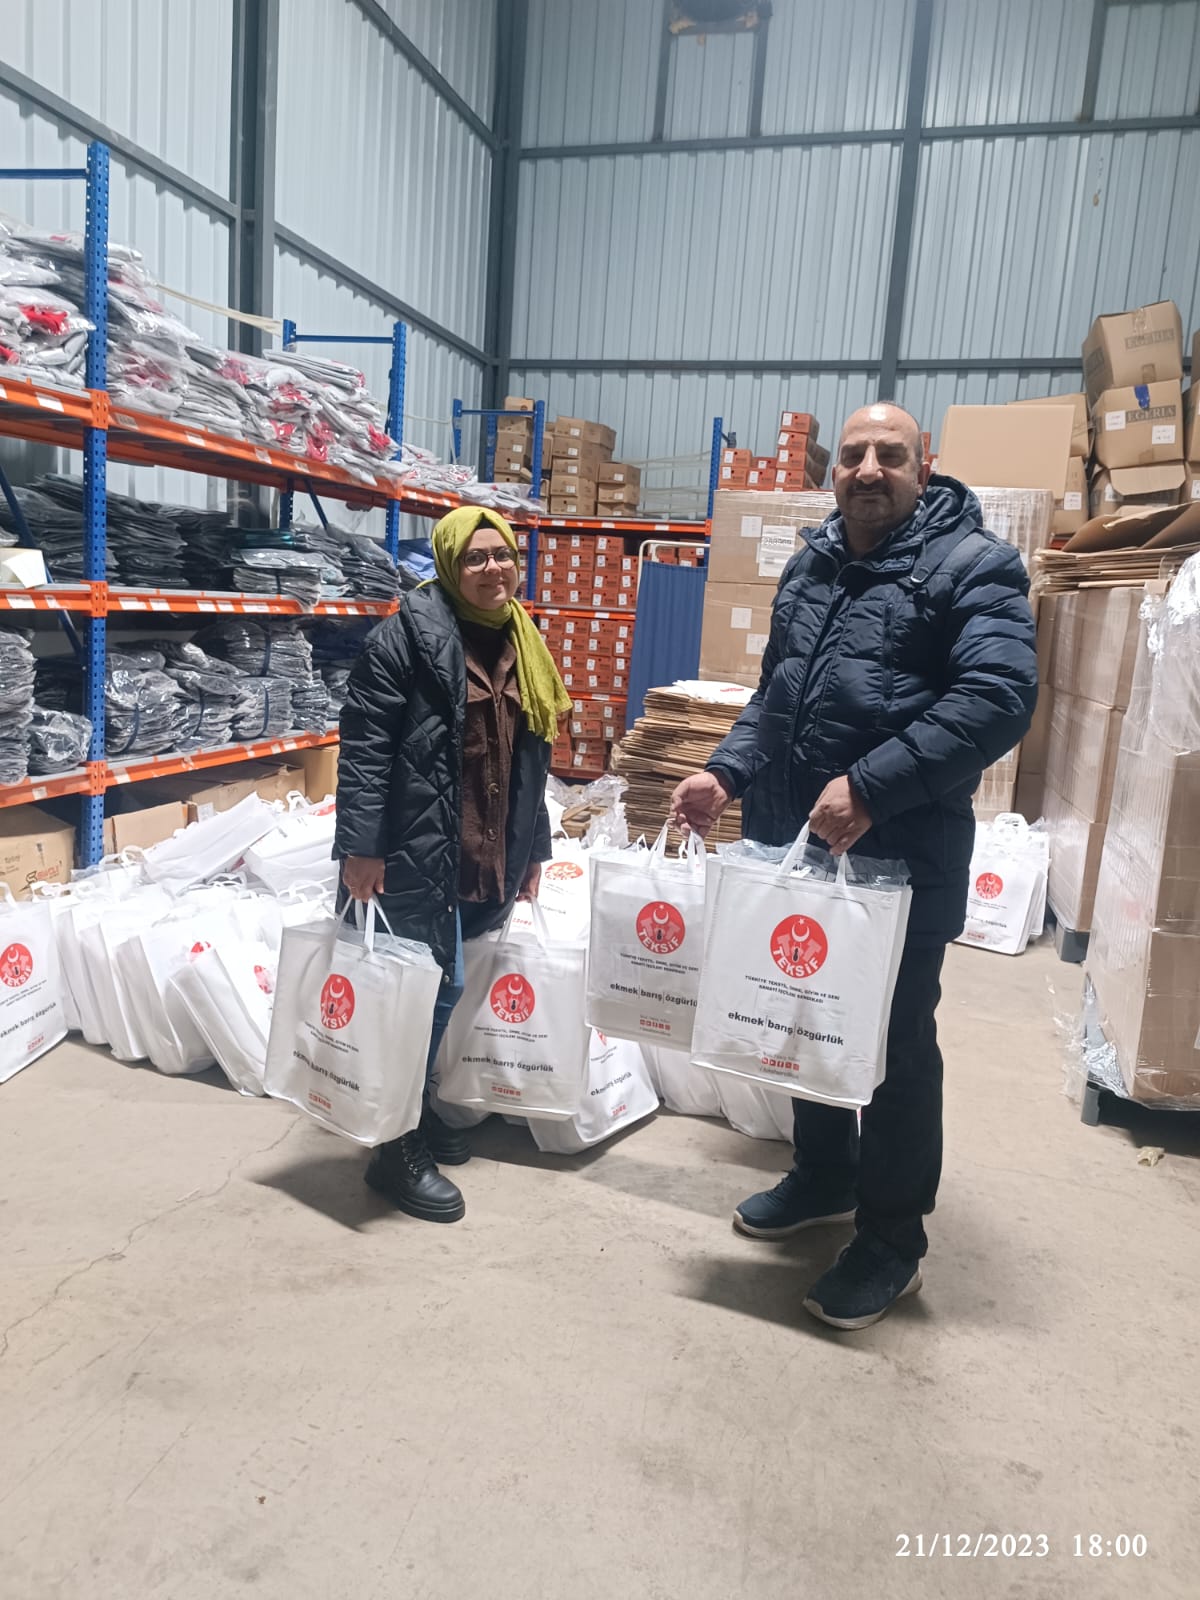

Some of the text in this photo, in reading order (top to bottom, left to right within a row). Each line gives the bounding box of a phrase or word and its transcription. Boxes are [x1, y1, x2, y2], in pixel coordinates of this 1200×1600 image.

[772, 946, 820, 977] TEKSİF
[609, 982, 698, 1008] ekmek barış özgürlü
[728, 1010, 844, 1046] ekmek barış özgürlük
[462, 1055, 554, 1073] ekmek barış özgürlük
